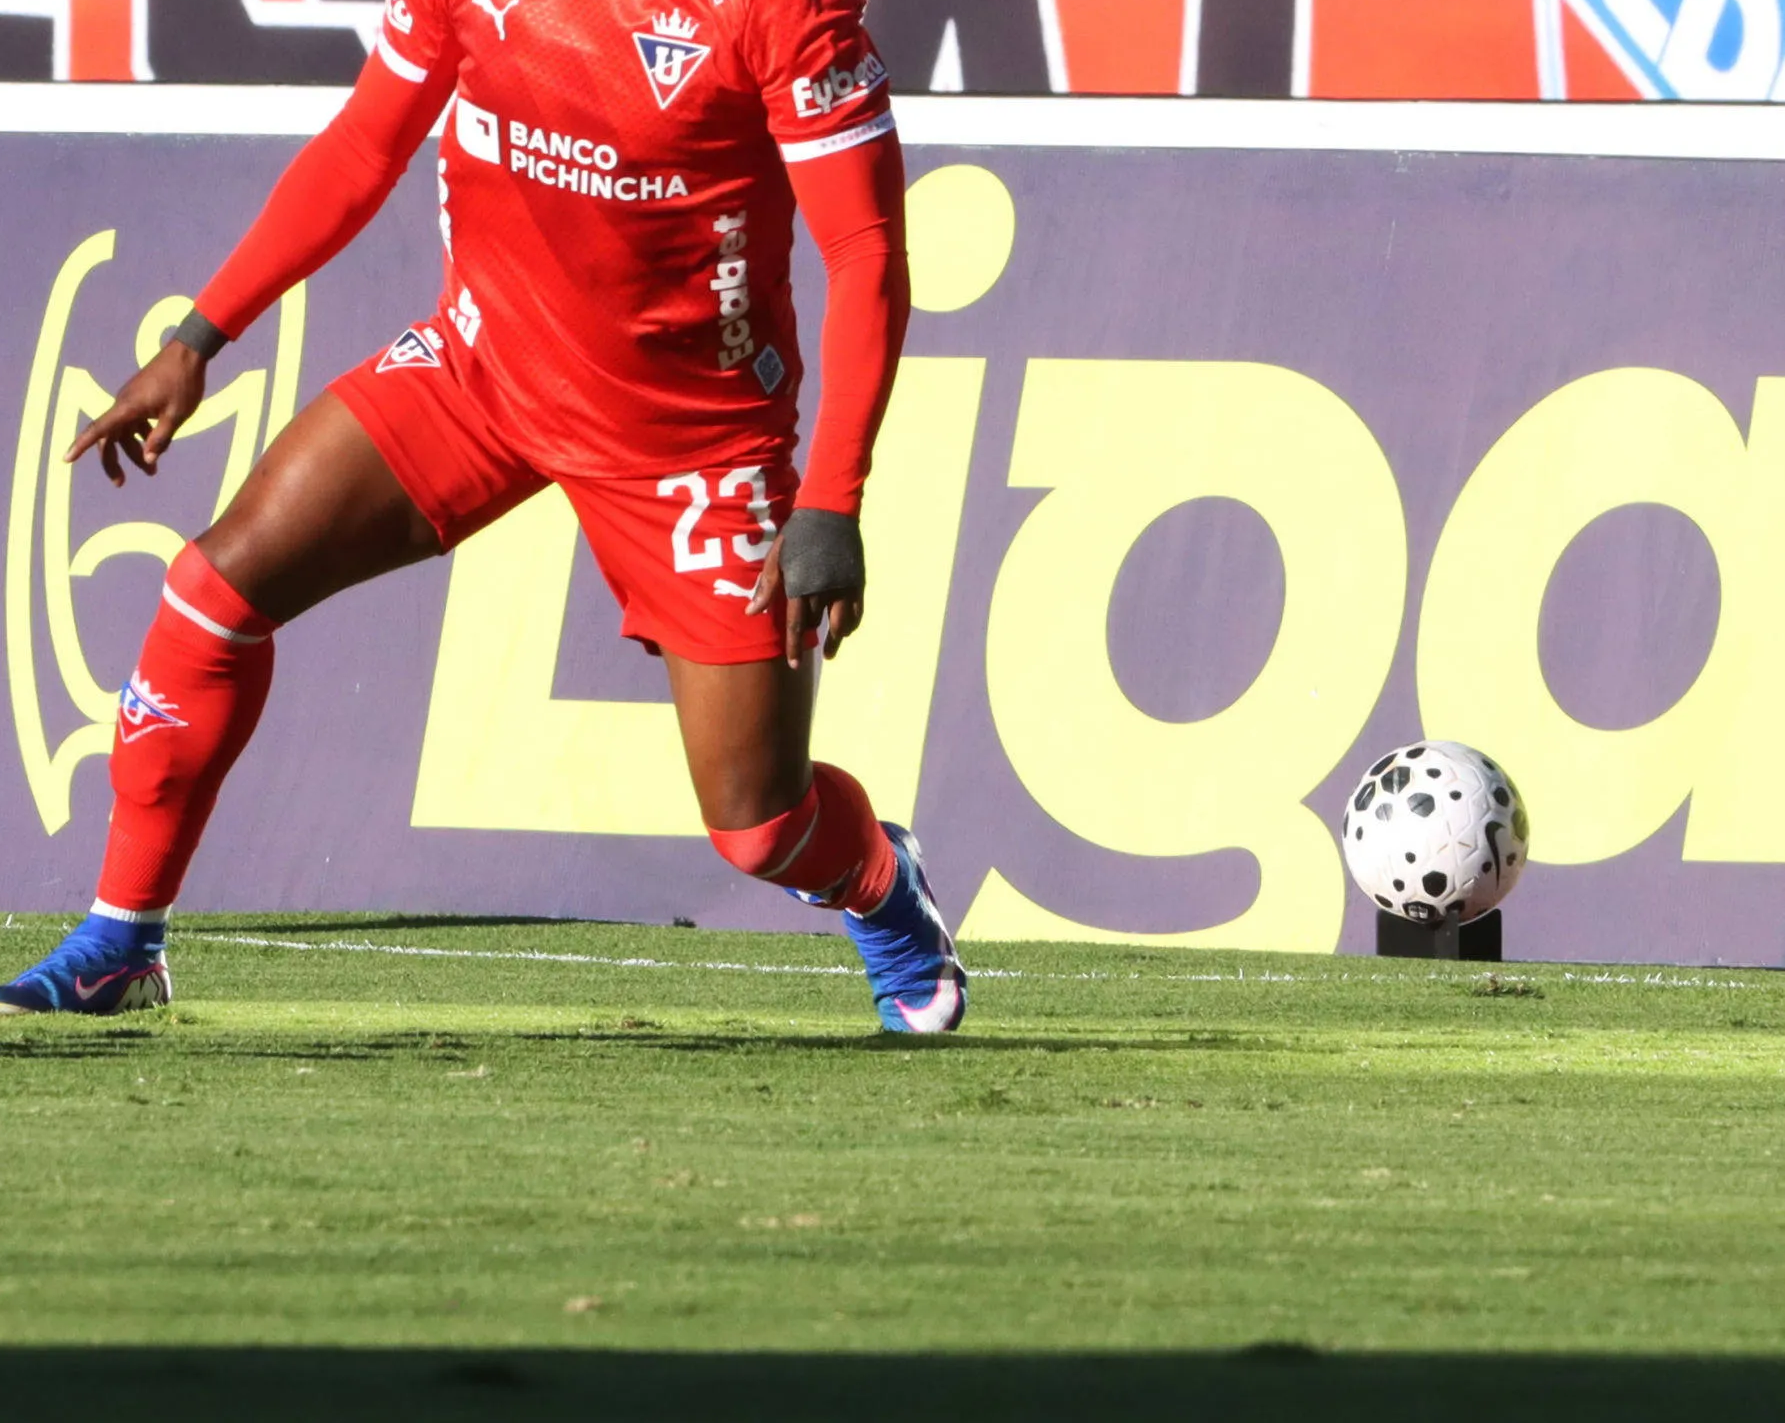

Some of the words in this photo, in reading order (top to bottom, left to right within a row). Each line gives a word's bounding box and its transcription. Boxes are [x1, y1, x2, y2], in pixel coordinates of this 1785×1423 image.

[509, 120, 618, 171] BANCO
[510, 148, 689, 201] PICHINCHA
[656, 464, 777, 574] 23
